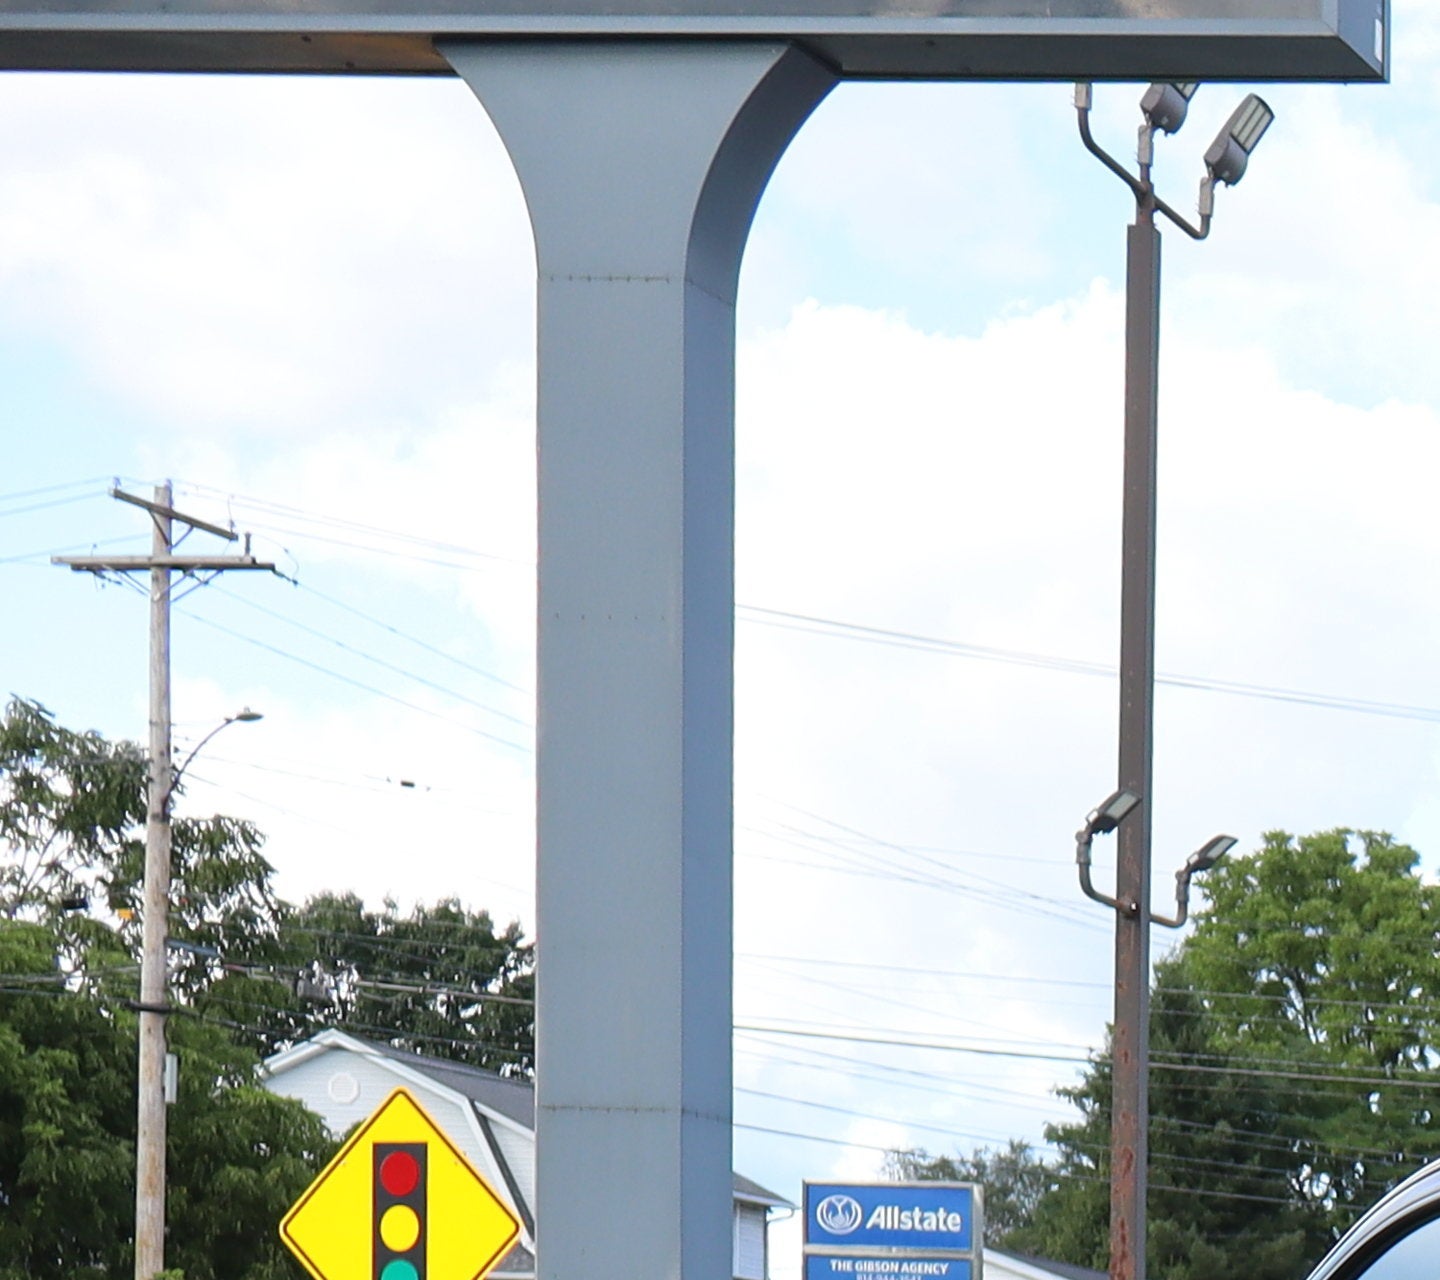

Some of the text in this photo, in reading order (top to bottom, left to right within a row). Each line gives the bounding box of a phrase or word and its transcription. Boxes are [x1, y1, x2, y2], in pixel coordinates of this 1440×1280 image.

[866, 1205, 962, 1233] Allstate
[830, 1259, 949, 1275] THE GIBSON AGENCY
